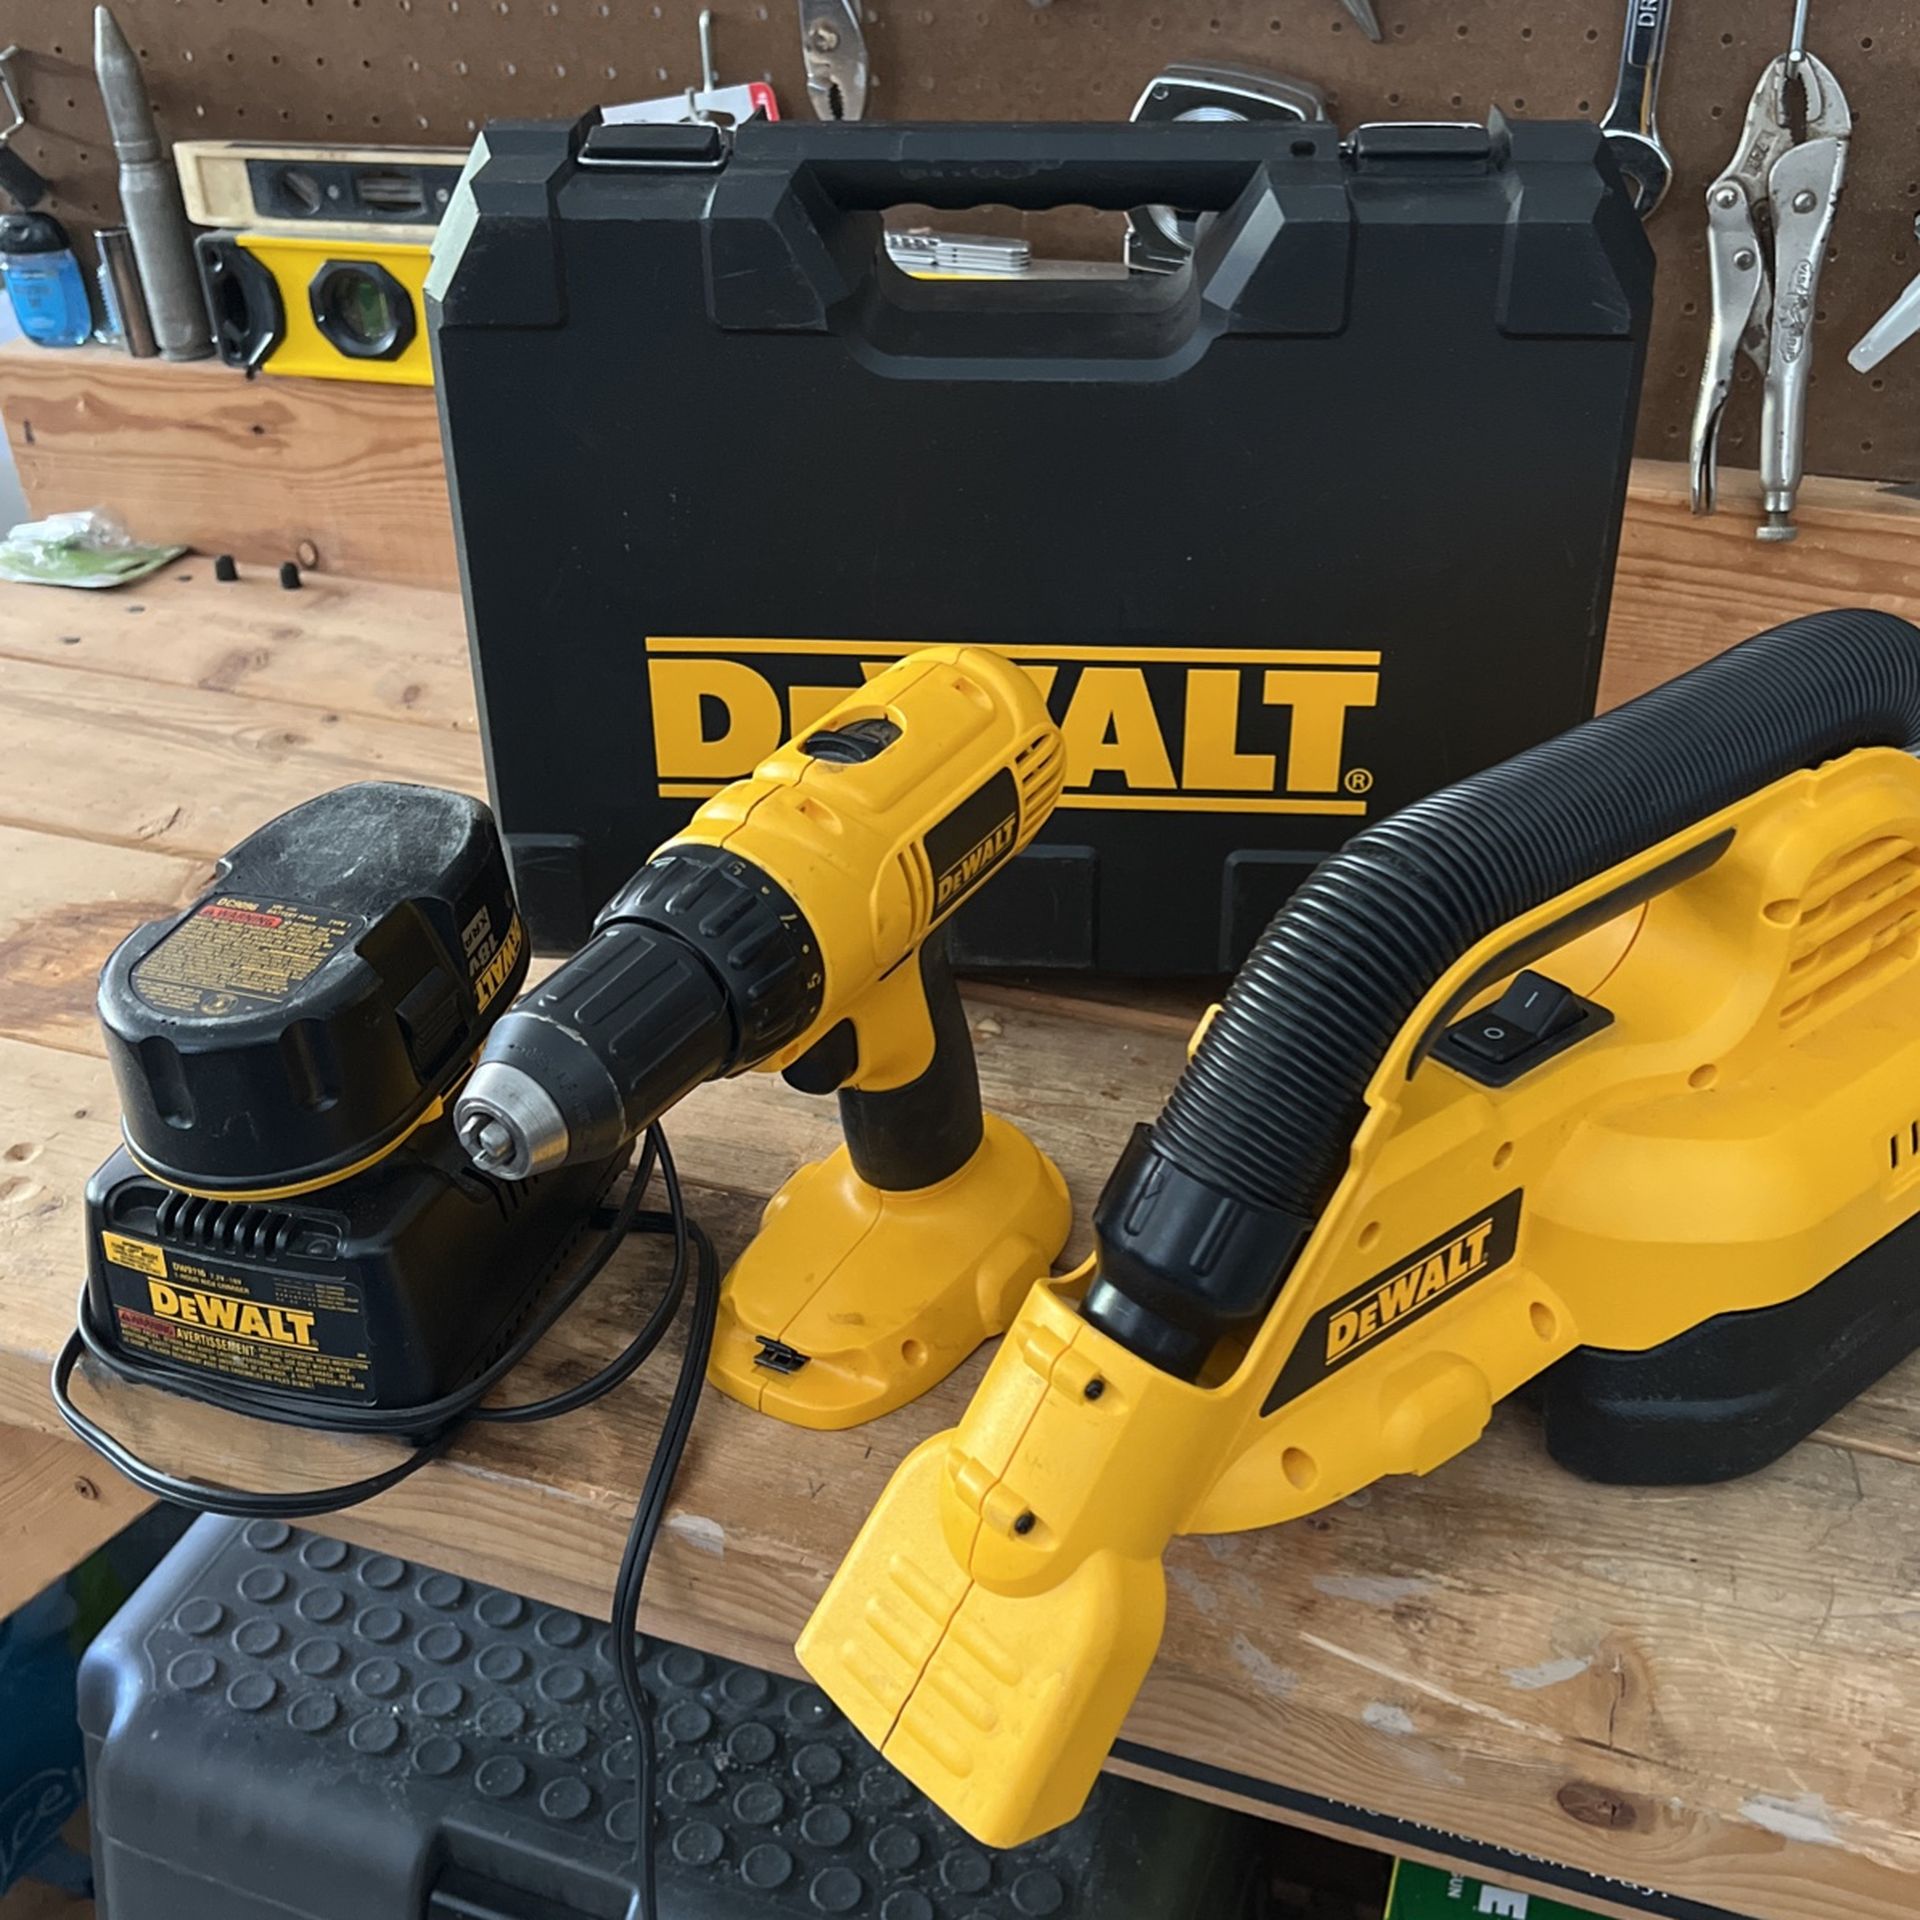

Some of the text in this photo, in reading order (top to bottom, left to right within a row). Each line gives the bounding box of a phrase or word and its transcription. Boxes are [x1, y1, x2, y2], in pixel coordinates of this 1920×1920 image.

[648, 658, 1379, 793] DALT
[937, 816, 1017, 905] DEWALT
[149, 1280, 316, 1346] DEWALT
[1327, 1222, 1493, 1361] DEWALT
